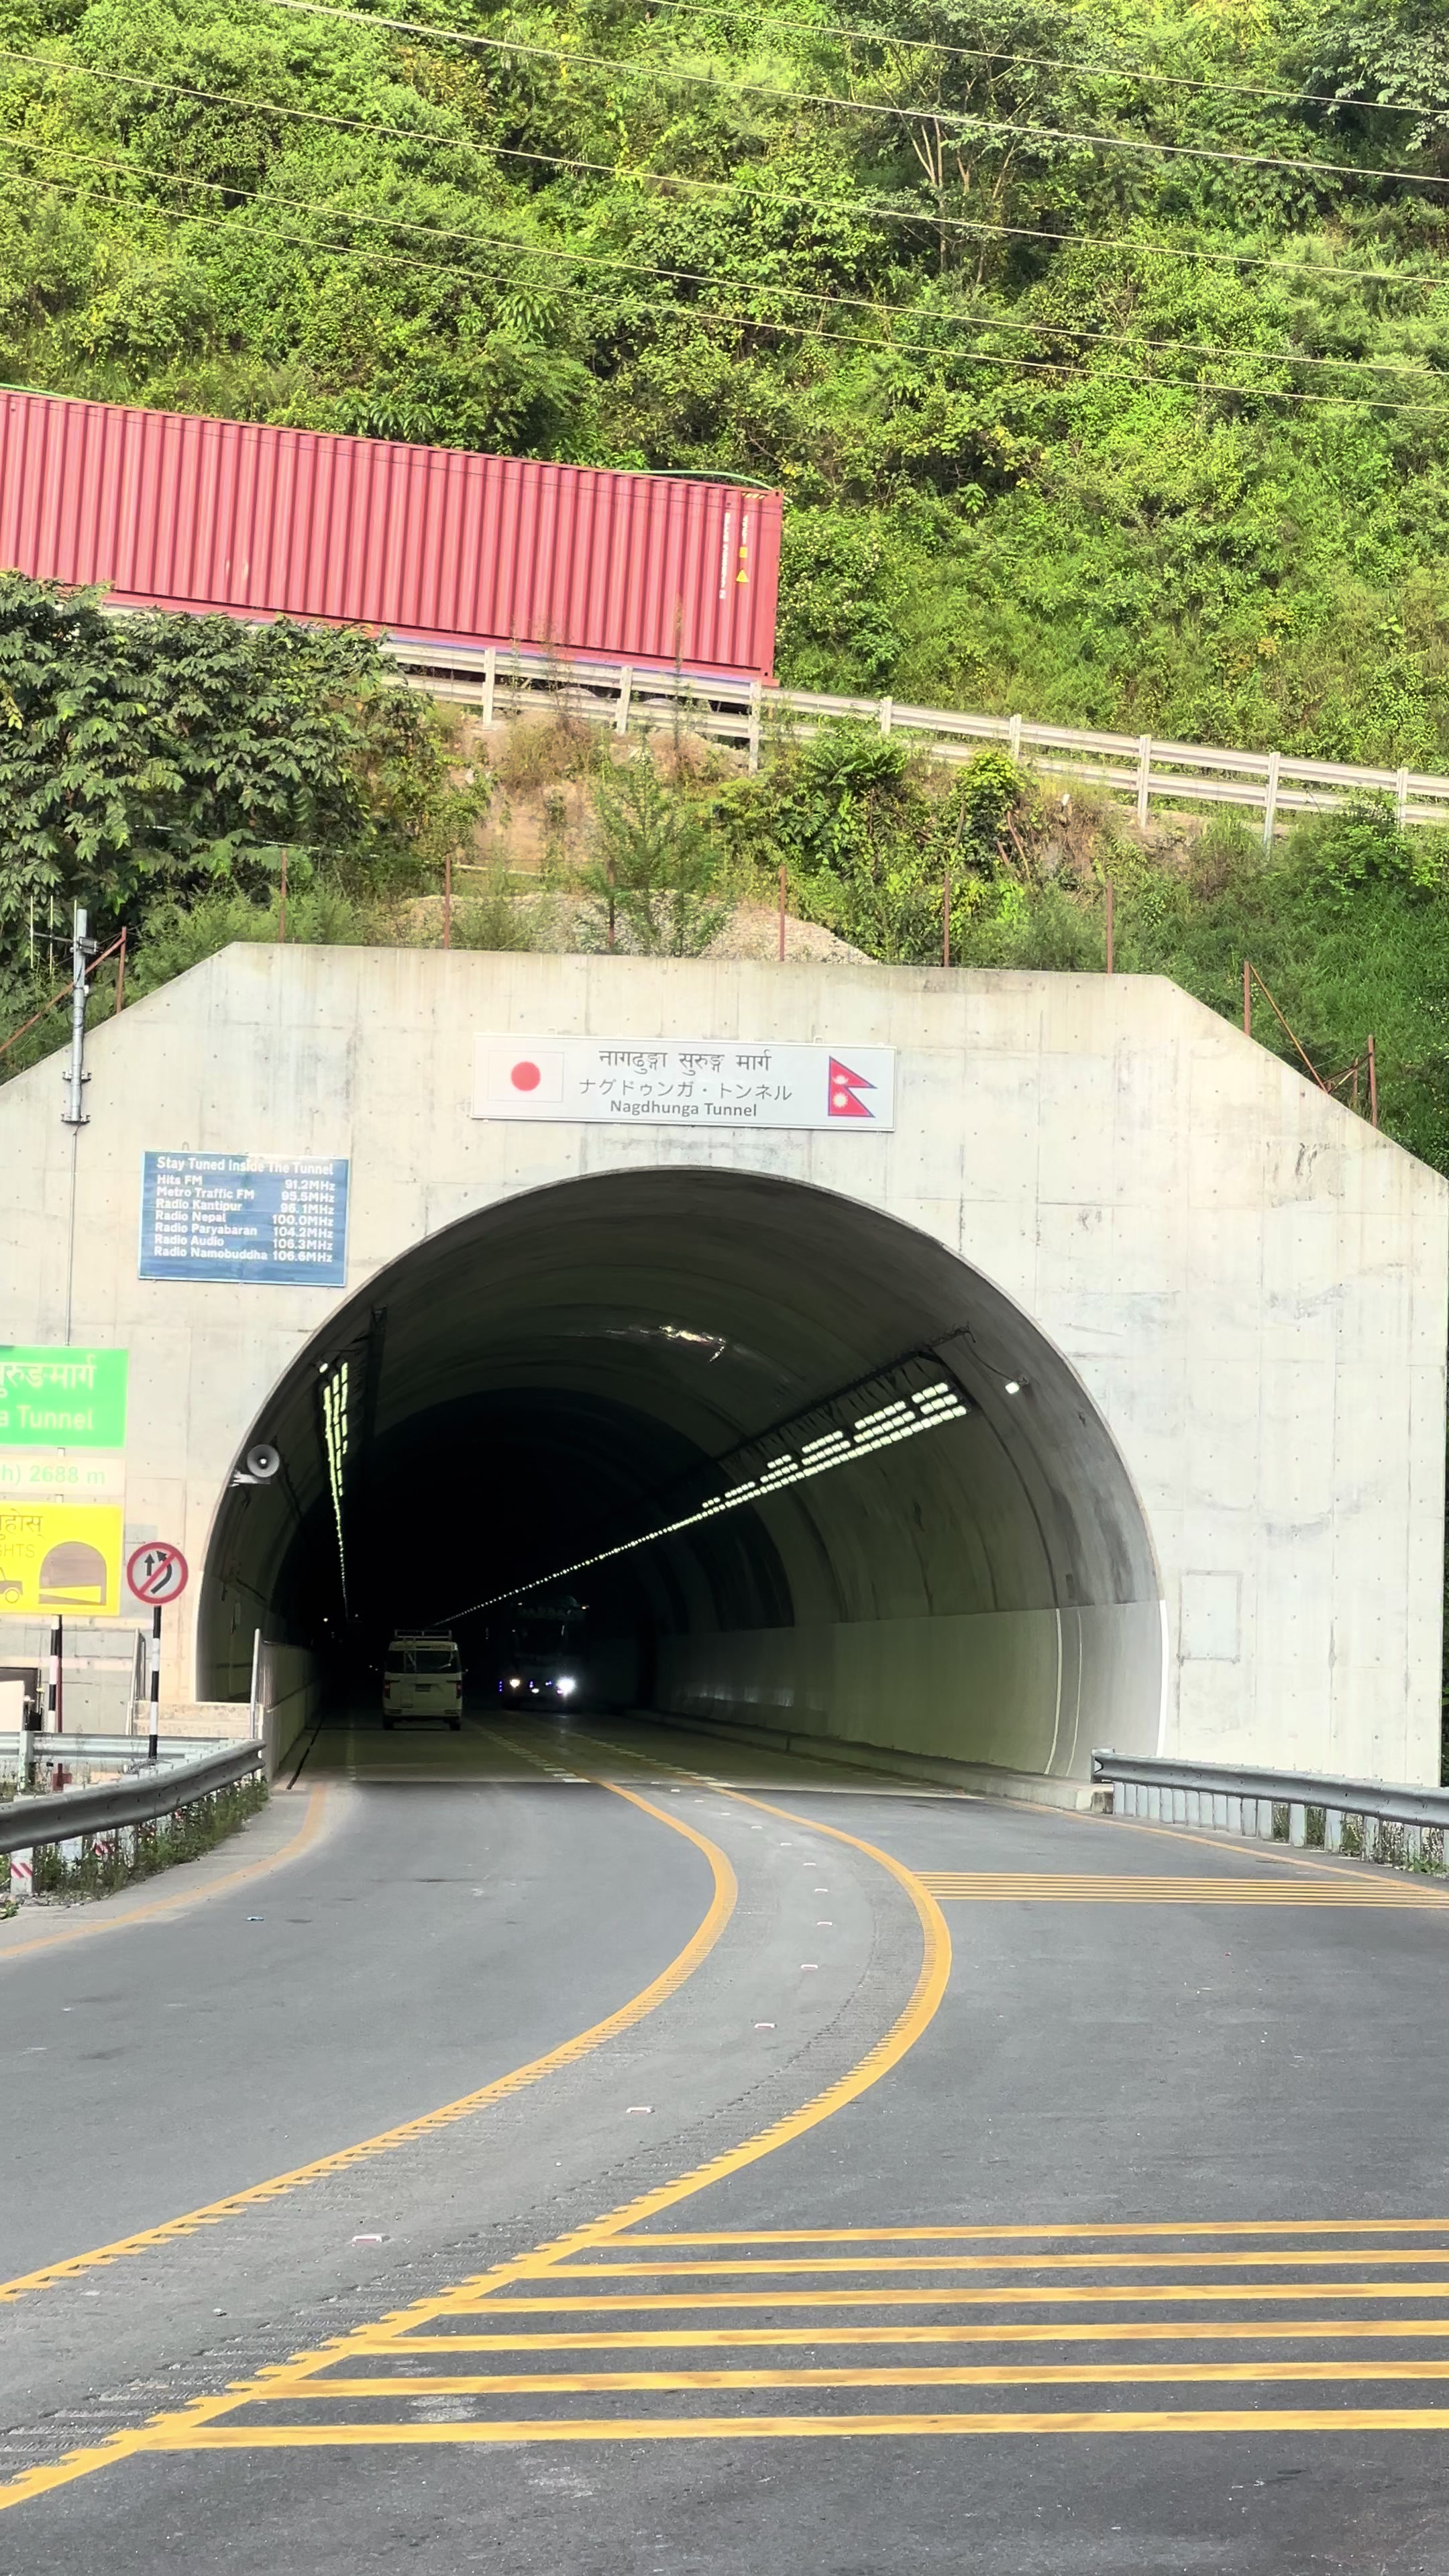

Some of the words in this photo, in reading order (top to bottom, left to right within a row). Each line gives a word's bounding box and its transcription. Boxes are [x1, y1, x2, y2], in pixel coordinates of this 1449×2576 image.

[736, 1049, 771, 1071] मार्ग
[579, 1079, 792, 1101] ナグドゥンガ・トンネル
[610, 1100, 699, 1117] Nagdhunga
[704, 1103, 757, 1117] Tunnel
[157, 1157, 184, 1171] Stay
[189, 1157, 225, 1171] Tuned
[229, 1159, 264, 1173] Inside
[268, 1161, 289, 1173] The
[293, 1163, 333, 1175] Tunnel
[158, 1175, 181, 1185] Hits
[185, 1176, 203, 1185] FM
[285, 1179, 335, 1191] 91.2MHz
[157, 1186, 191, 1197] Metro
[195, 1188, 233, 1198] Traffic
[237, 1189, 254, 1199] FM
[282, 1191, 335, 1203] 95.5MHz
[156, 1198, 189, 1210] Radio
[193, 1200, 242, 1212] Kantipur
[156, 1210, 189, 1221] Radio
[193, 1212, 226, 1224] Nepal
[272, 1214, 333, 1226] 100.0MHz
[156, 1222, 188, 1233] Radio
[192, 1224, 258, 1237] Paryabaran
[273, 1226, 333, 1238] 104.2MHz
[155, 1234, 187, 1245] Radio
[191, 1236, 224, 1246] Audio
[273, 1238, 332, 1250] 106.3MHz
[154, 1246, 186, 1257] Radio
[191, 1248, 268, 1260] Namobuddha
[273, 1250, 332, 1263] 106.6MHz
[17, 1405, 94, 1430] Tunnel
[30, 1466, 78, 1483] 2688
[87, 1471, 105, 1484] m
